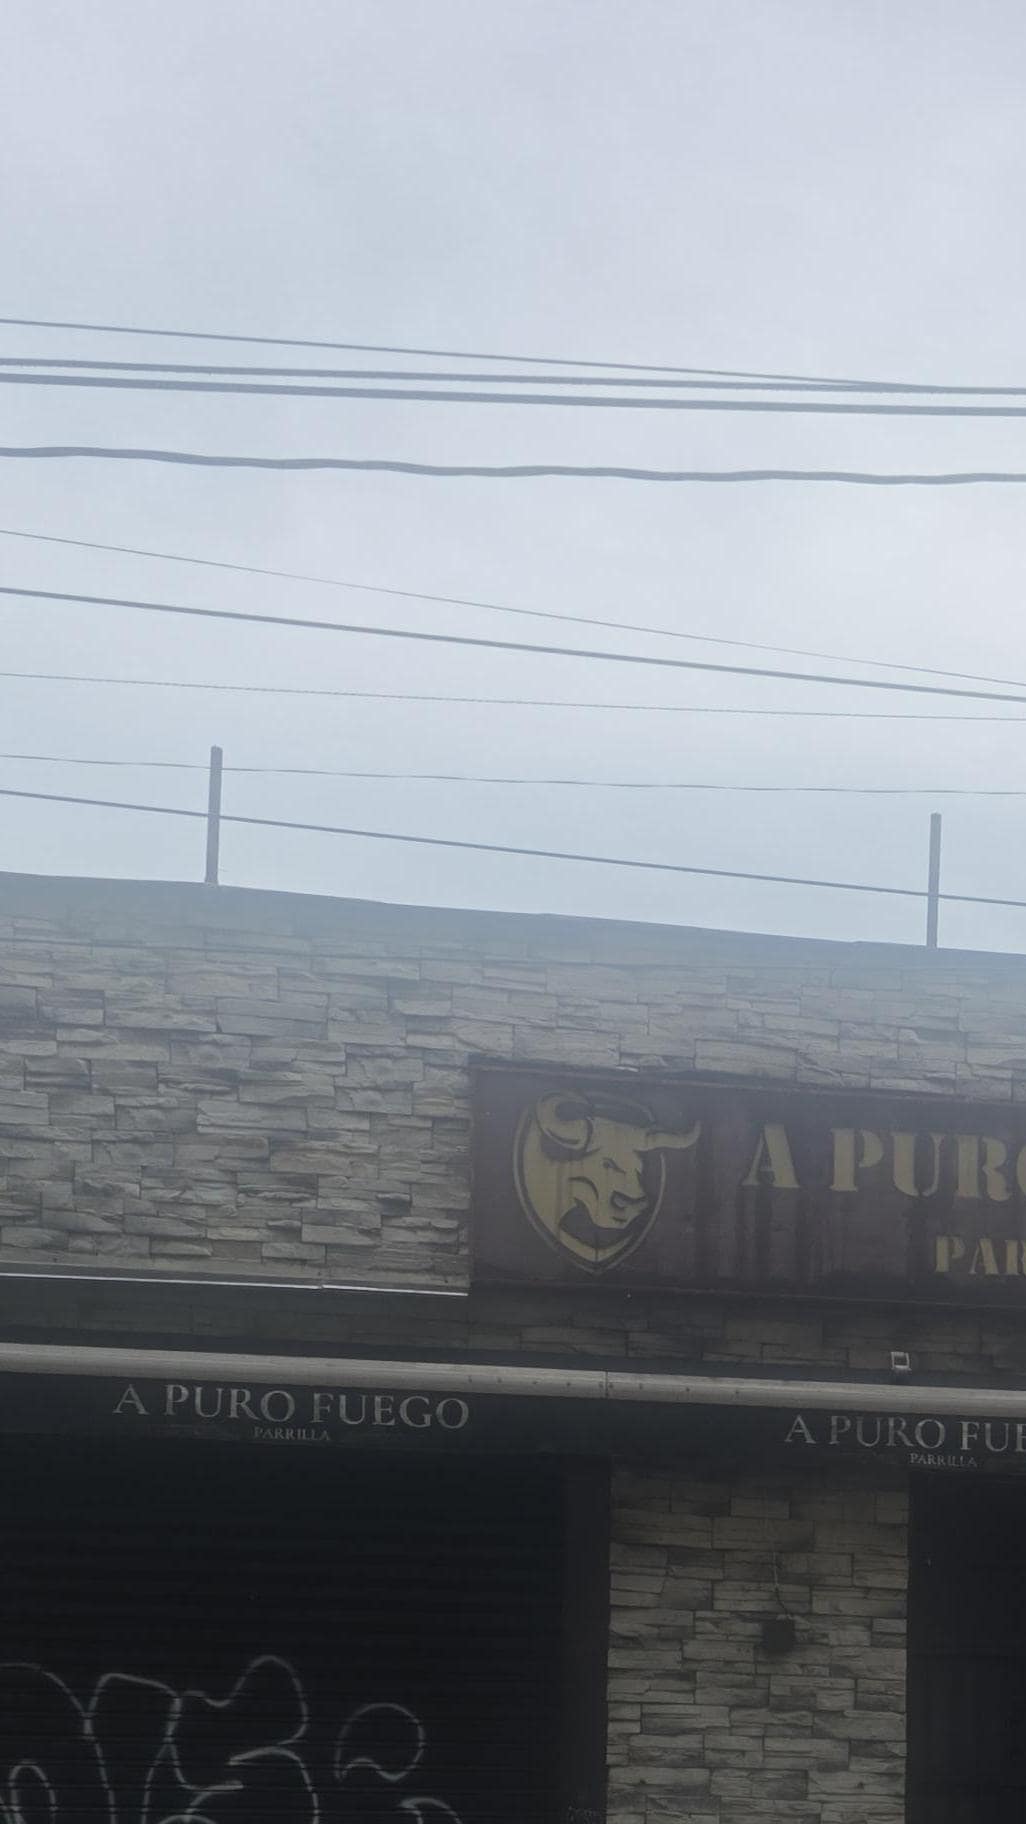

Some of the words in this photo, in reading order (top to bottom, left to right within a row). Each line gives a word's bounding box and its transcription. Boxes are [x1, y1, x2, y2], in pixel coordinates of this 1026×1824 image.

[741, 1122, 801, 1189] A
[112, 1383, 151, 1416] A
[163, 1384, 296, 1423] PURO
[309, 1392, 470, 1430] FUEGO
[252, 1425, 331, 1442] PARRILLA
[784, 1414, 817, 1444] A
[828, 1415, 946, 1449] PURO
[909, 1452, 979, 1468] PARRILLA
